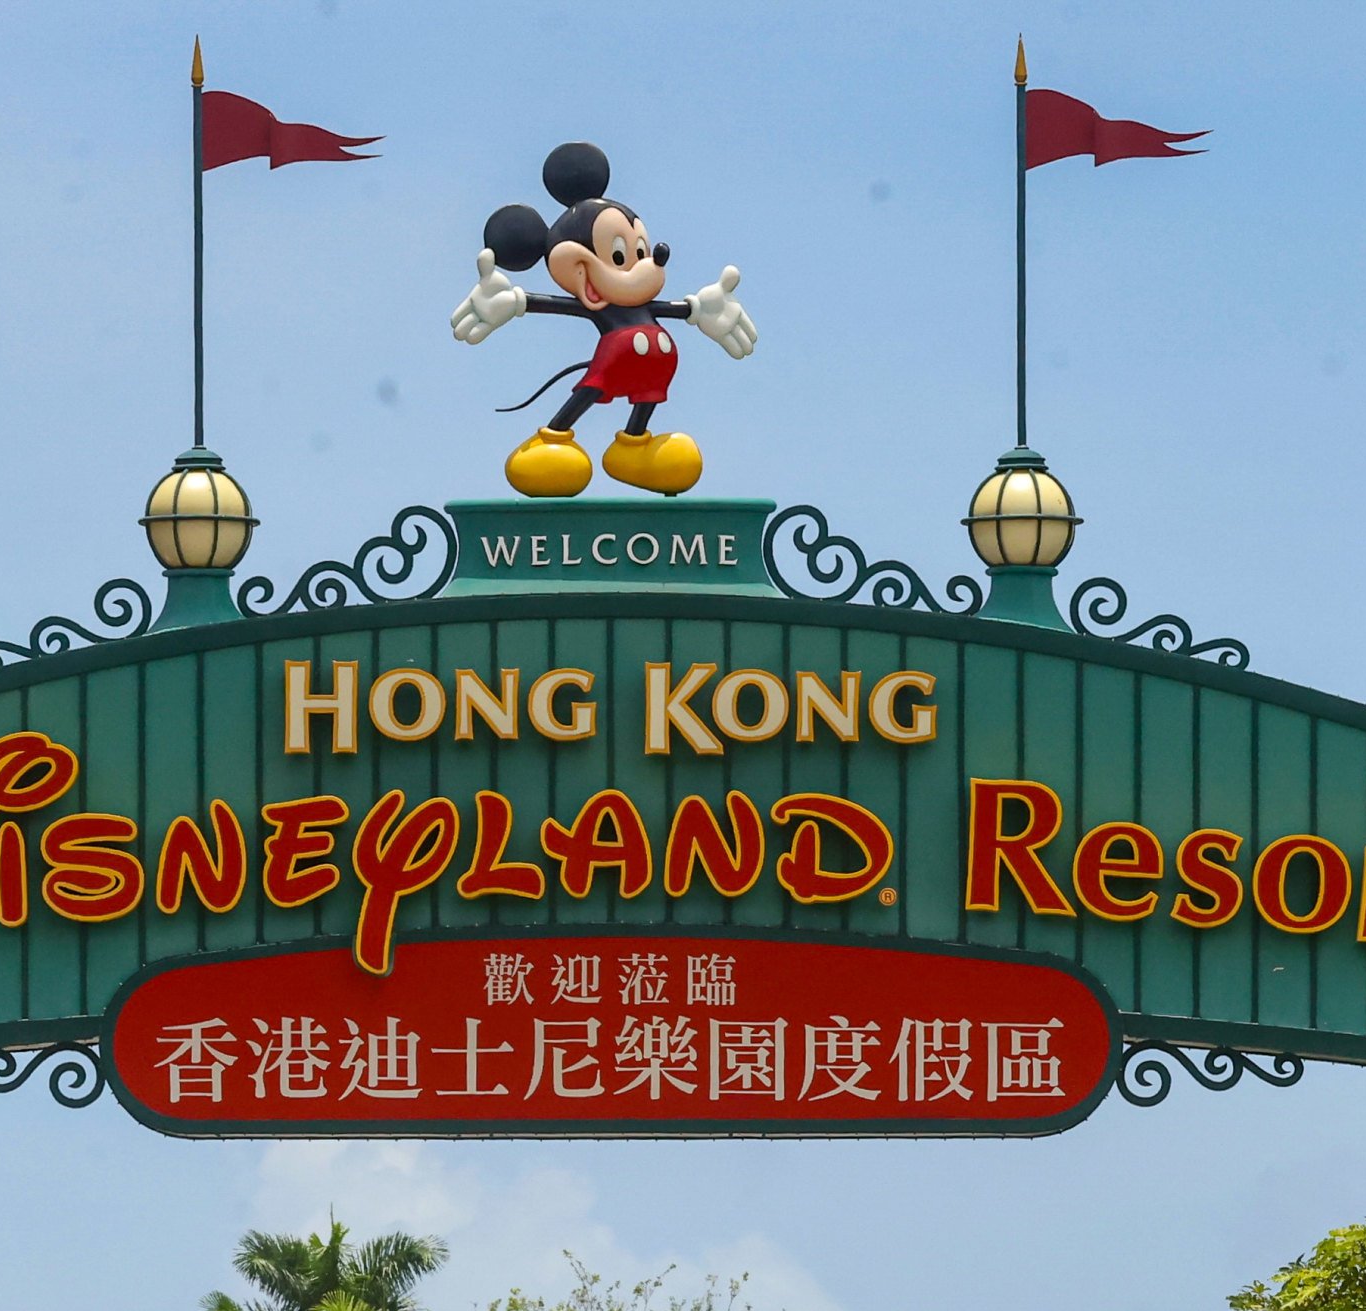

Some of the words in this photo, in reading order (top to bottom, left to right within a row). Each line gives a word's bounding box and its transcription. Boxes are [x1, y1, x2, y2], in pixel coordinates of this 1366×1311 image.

[480, 532, 739, 568] WELCOME
[283, 660, 597, 754] HONG
[644, 661, 938, 756] KONG
[483, 953, 737, 1006] 歡迎蒞臨
[153, 1015, 1067, 1103] 香港迪士尼樂園度假區
